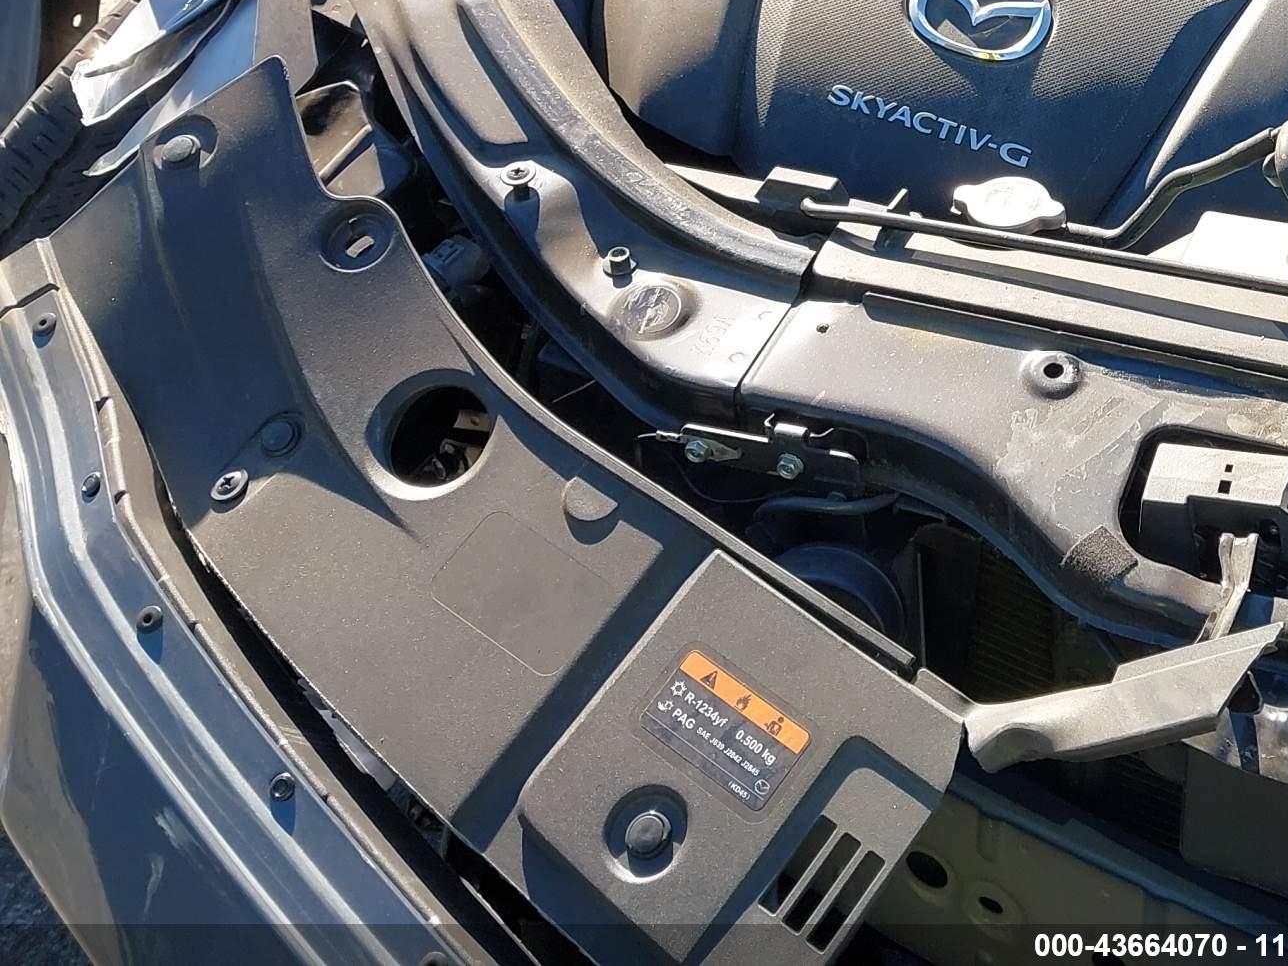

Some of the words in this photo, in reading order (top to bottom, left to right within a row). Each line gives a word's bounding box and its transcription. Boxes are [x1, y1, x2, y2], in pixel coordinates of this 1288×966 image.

[827, 84, 1032, 168] SKYACTIV-G
[672, 708, 696, 730] PAG
[696, 727, 711, 741] SAE
[684, 692, 729, 728] R-1234yf
[735, 729, 763, 755] 0.500
[762, 748, 777, 766] kg
